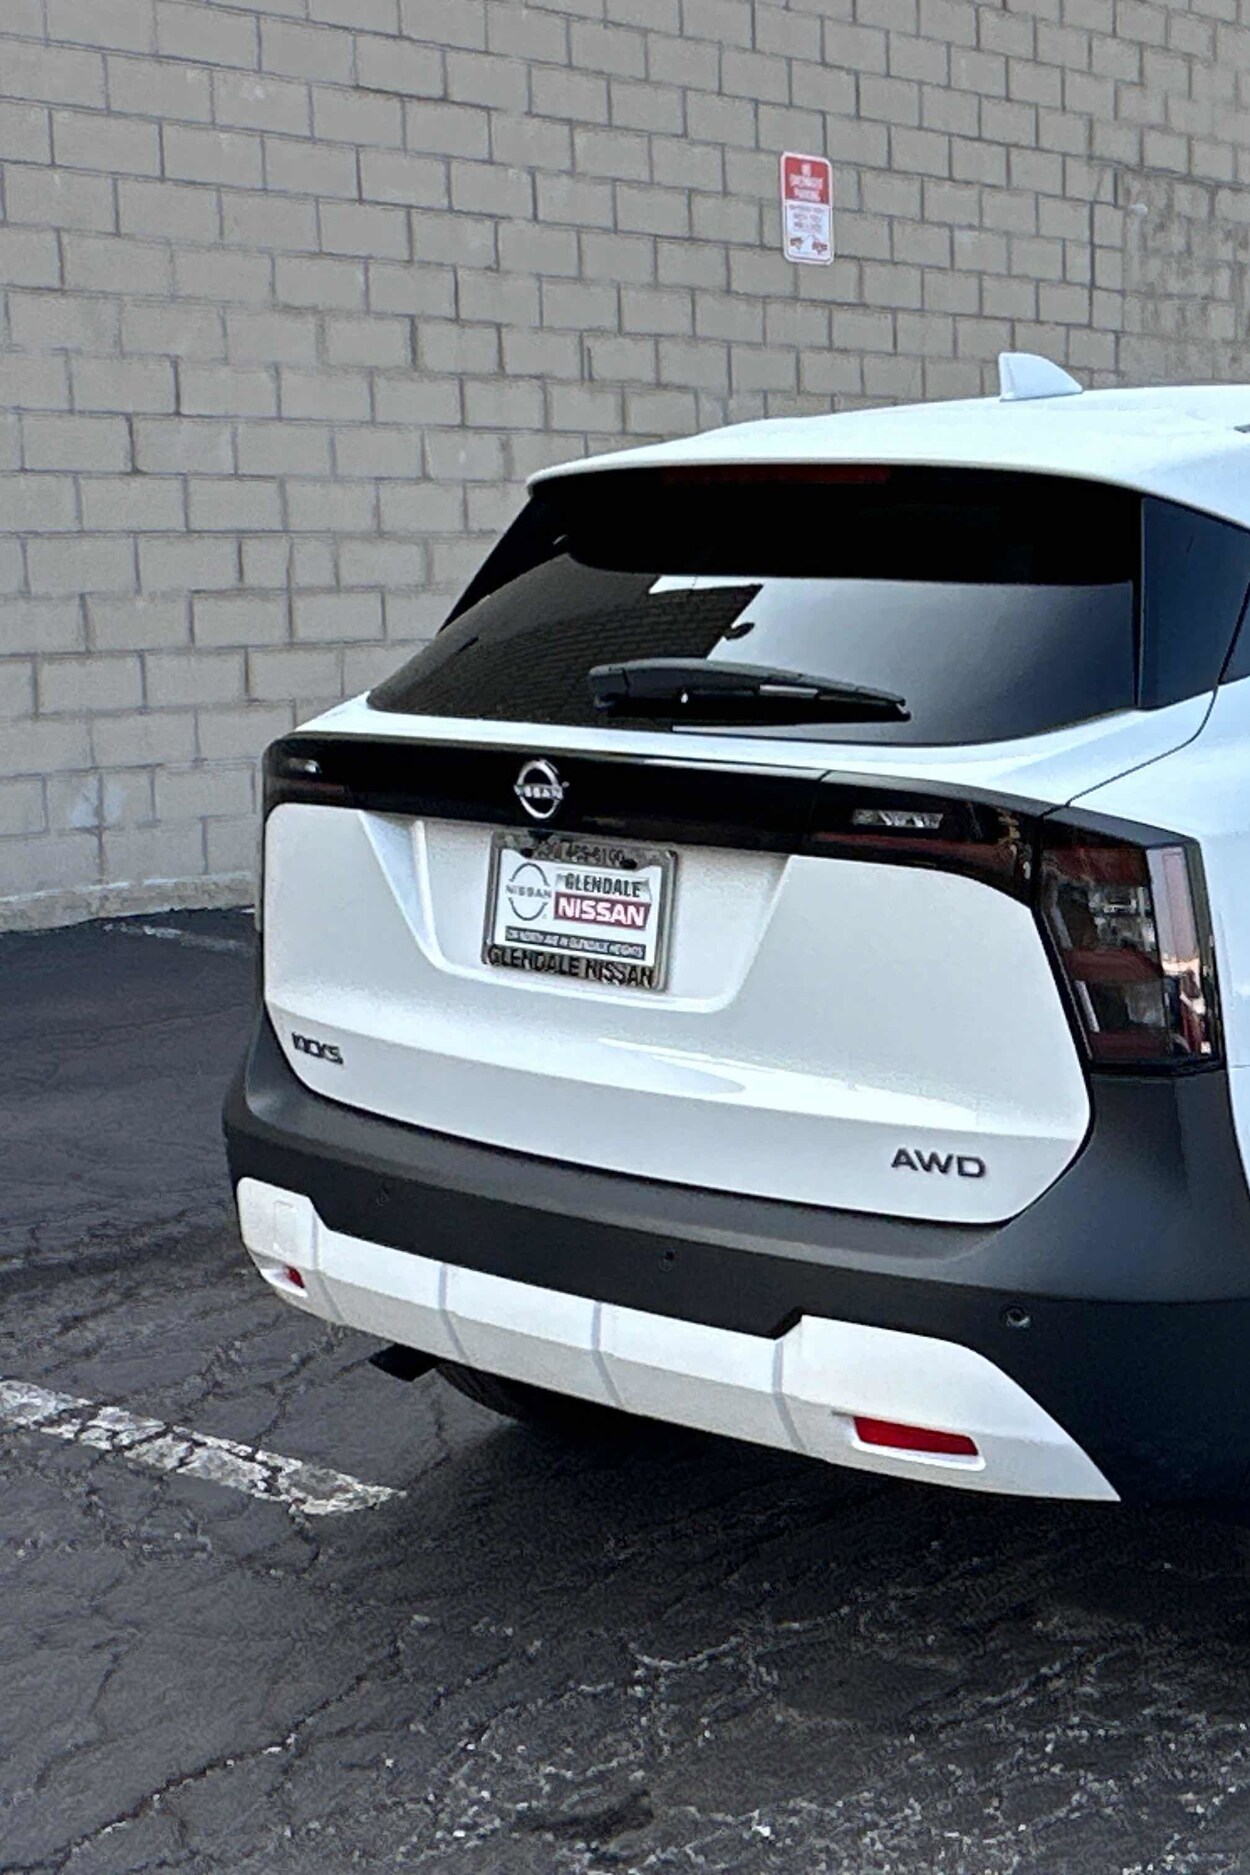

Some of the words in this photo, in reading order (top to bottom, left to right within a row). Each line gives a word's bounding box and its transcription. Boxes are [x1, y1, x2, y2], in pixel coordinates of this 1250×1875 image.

[513, 783, 564, 800] NISSAN
[505, 884, 552, 899] NISSAN
[564, 872, 641, 898] GLENDALE
[558, 896, 646, 927] NISSAN
[487, 943, 579, 976] GLENDALE
[584, 957, 655, 988] NISSAN
[891, 1147, 986, 1178] AWD
